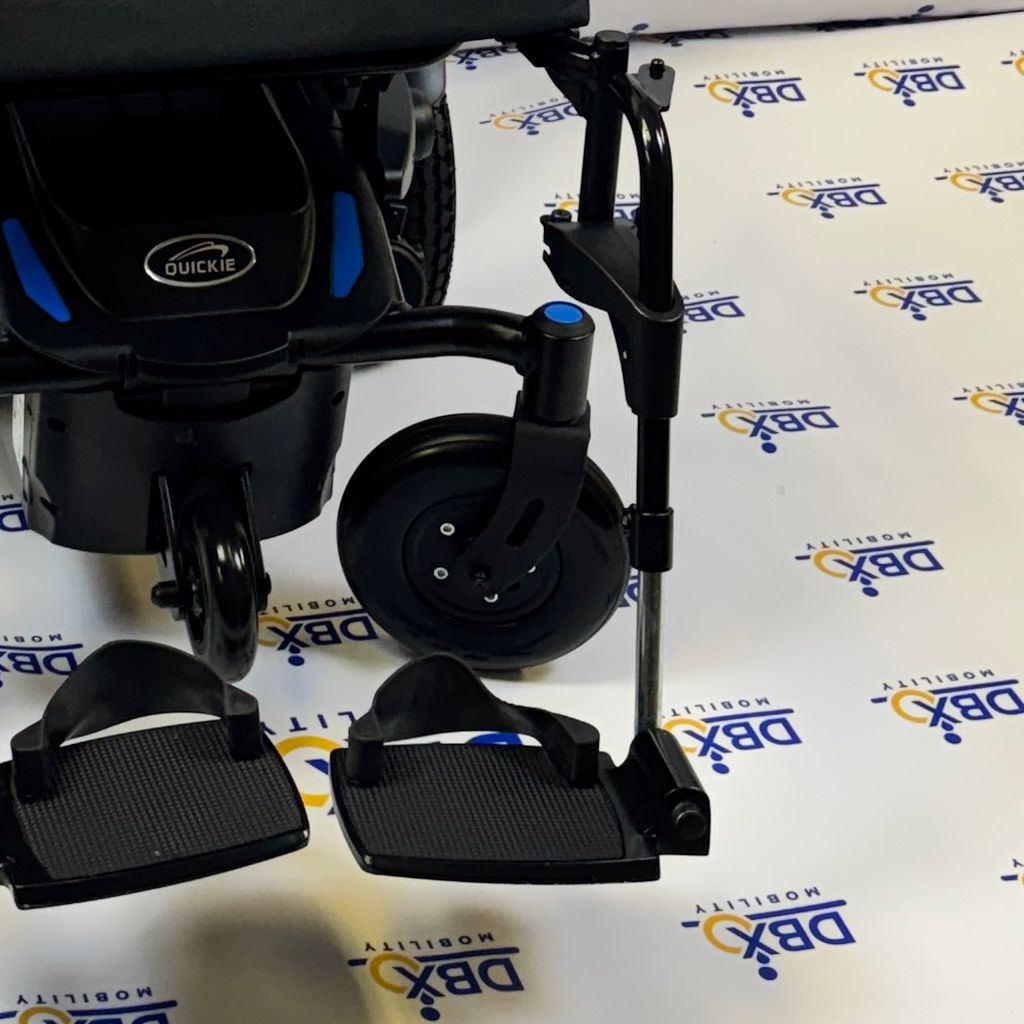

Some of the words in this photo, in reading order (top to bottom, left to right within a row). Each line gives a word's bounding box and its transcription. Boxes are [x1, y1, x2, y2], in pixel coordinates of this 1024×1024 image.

[862, 57, 944, 70] MOBILITY
[704, 69, 786, 81] MOBILITY
[881, 71, 965, 95] DBX
[719, 82, 806, 106] DBX
[491, 97, 559, 118] OBILITY
[777, 177, 861, 188] MOBILITY
[966, 175, 1024, 193] BX
[799, 189, 886, 211] DBX
[165, 258, 236, 276] QUICKIE
[864, 274, 954, 286] MOBILITY
[888, 286, 982, 311] DBX
[684, 301, 745, 322] DB
[713, 400, 810, 409] MOBILITY
[738, 411, 839, 435] DBX
[807, 532, 911, 550] MOBILITY
[833, 548, 944, 582] DBX
[271, 596, 356, 614] MOBILI
[267, 616, 379, 651] DBX
[883, 669, 994, 691] MOBILITY
[668, 698, 771, 716] MOBILIT
[912, 688, 1024, 727] DBX
[683, 717, 802, 757] DBX
[696, 887, 820, 914] MOBILITY
[365, 932, 495, 952] MOBILITY
[726, 911, 856, 960] DBX
[392, 957, 524, 999] DBX
[17, 986, 153, 1006] MOBILITY
